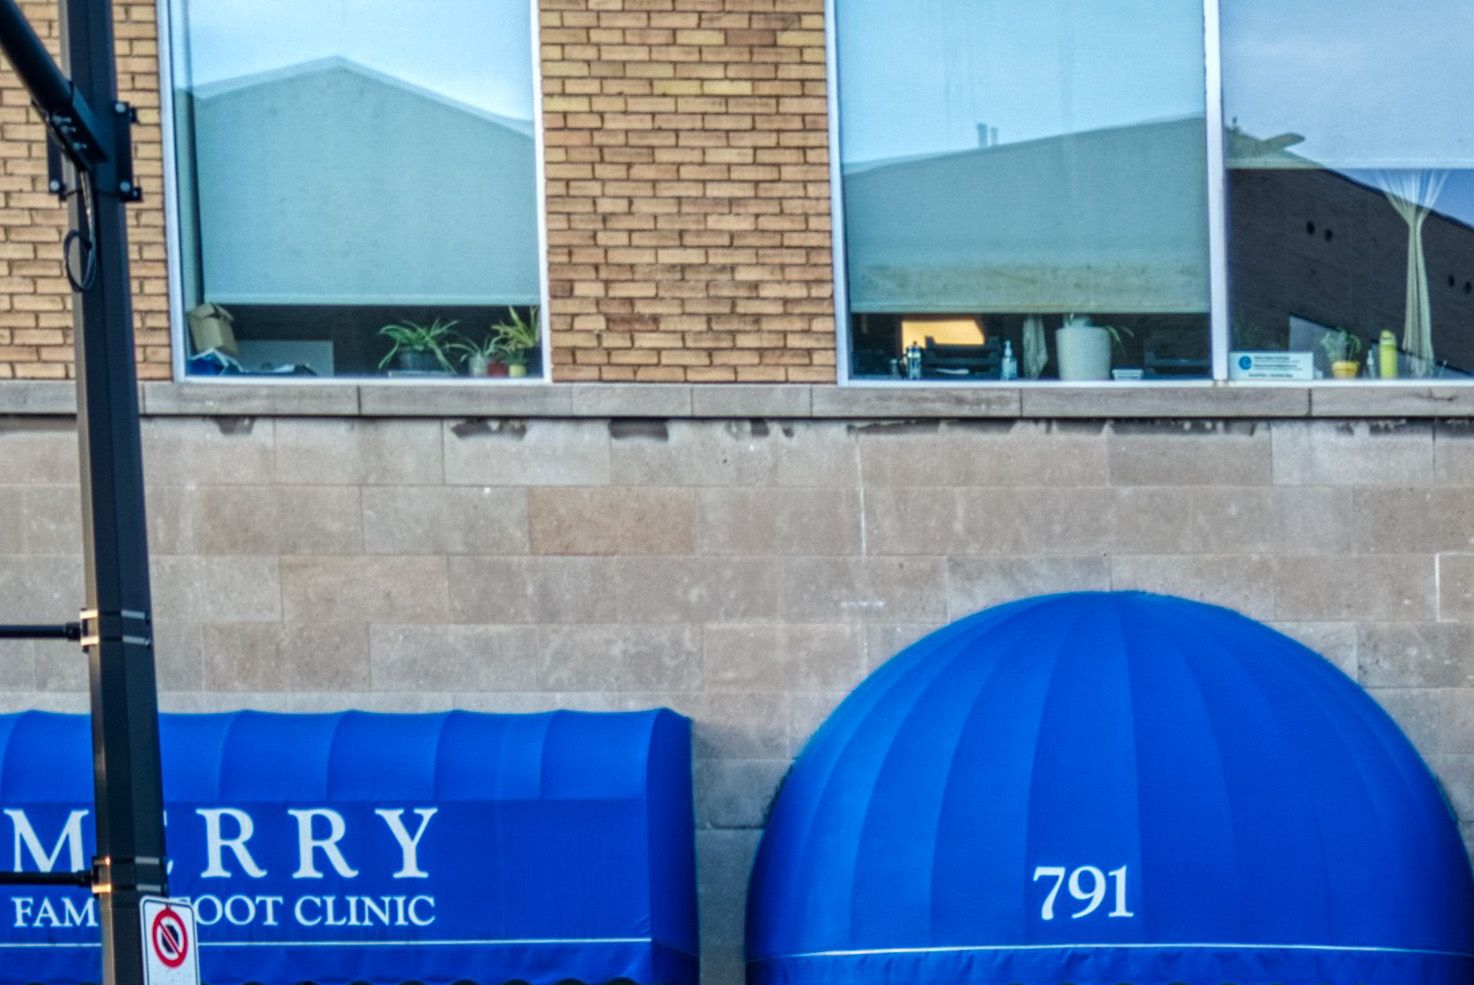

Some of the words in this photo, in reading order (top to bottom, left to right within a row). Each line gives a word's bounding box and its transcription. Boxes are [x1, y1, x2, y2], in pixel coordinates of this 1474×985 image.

[3, 808, 437, 879] MRRY
[168, 895, 283, 927] OOT
[294, 895, 435, 927] CLINIC
[1033, 865, 1134, 920] 791
